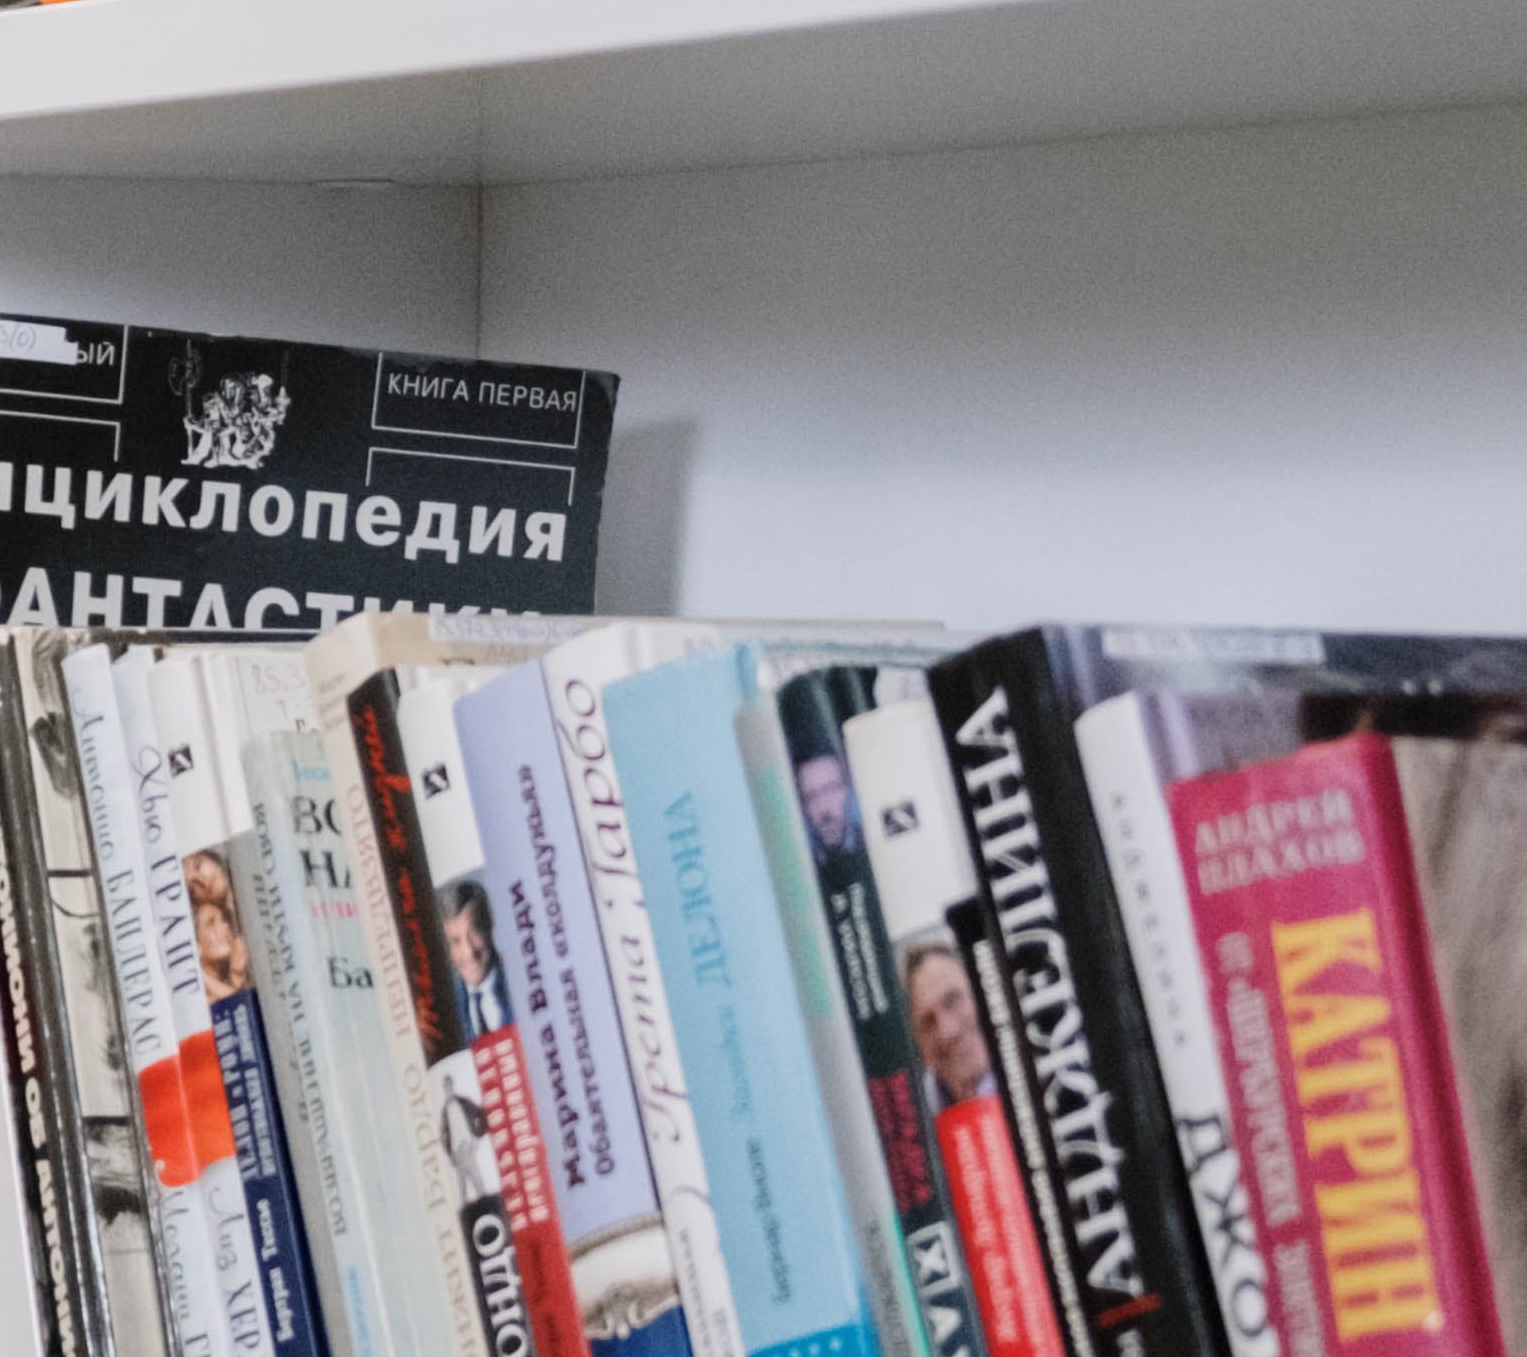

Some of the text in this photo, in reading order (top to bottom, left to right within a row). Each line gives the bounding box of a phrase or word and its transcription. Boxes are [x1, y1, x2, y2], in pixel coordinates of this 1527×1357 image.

[388, 374, 576, 411] КНИГА ПЕРВАЯ
[151, 854, 200, 992] ГРАНТ
[504, 880, 584, 1189] Марина Влади
[953, 689, 1142, 1305] АНДЖЕЛИНА
[1272, 908, 1448, 1339] КАТРИН
